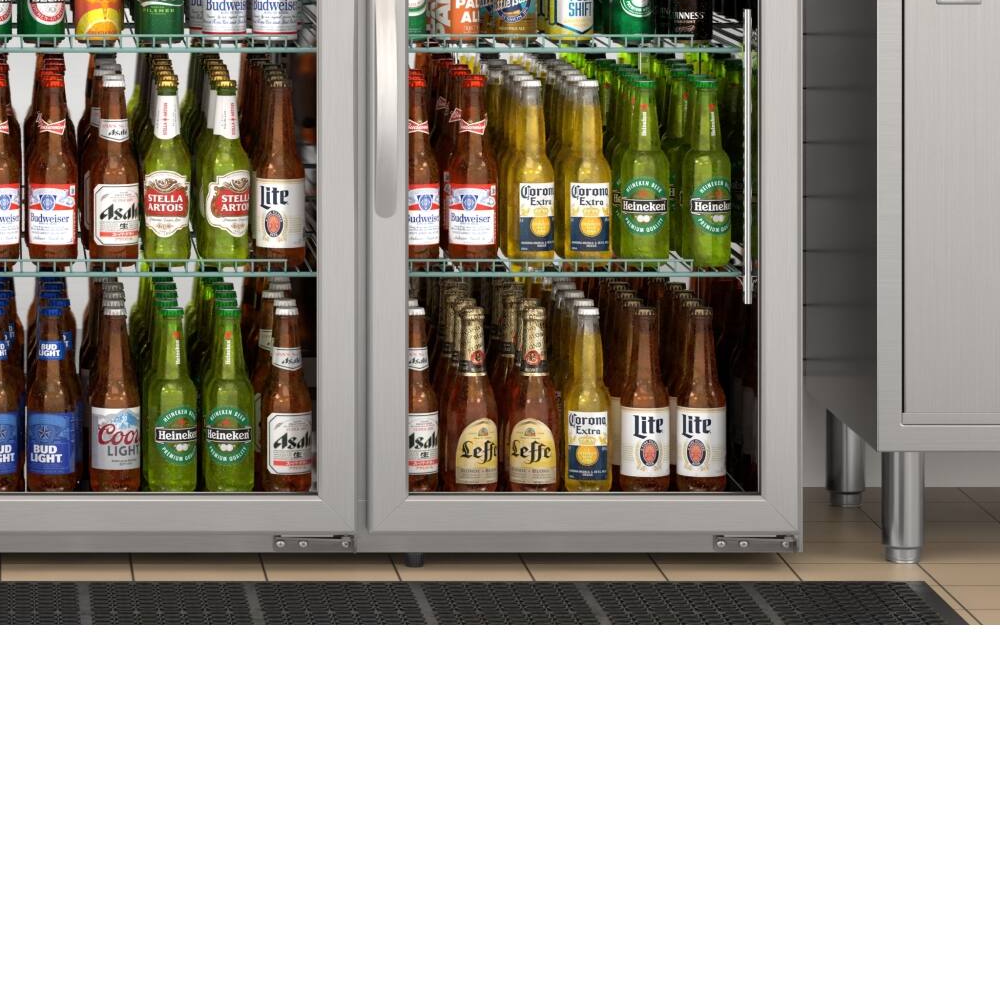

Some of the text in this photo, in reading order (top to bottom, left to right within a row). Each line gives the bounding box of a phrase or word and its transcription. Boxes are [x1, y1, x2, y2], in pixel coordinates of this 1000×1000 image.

[569, 2, 593, 17] SHIFT
[461, 11, 479, 23] AL
[260, 185, 289, 209] Lite
[520, 184, 554, 199] Coron
[571, 184, 609, 199] Corona
[147, 194, 184, 203] STELLA
[579, 197, 604, 206] Extra
[147, 203, 184, 213] ARTOIS
[622, 200, 666, 212] Heineken
[30, 212, 70, 223] Budweiser
[450, 212, 491, 223] Budweiser
[568, 413, 607, 428] Corona
[633, 414, 664, 439] Lite
[681, 414, 712, 439] Lite
[207, 429, 250, 440] Heineken
[575, 426, 601, 435] Extra
[33, 444, 58, 454] BUD
[511, 440, 552, 465] Leffe
[30, 453, 63, 463] LIGHT
